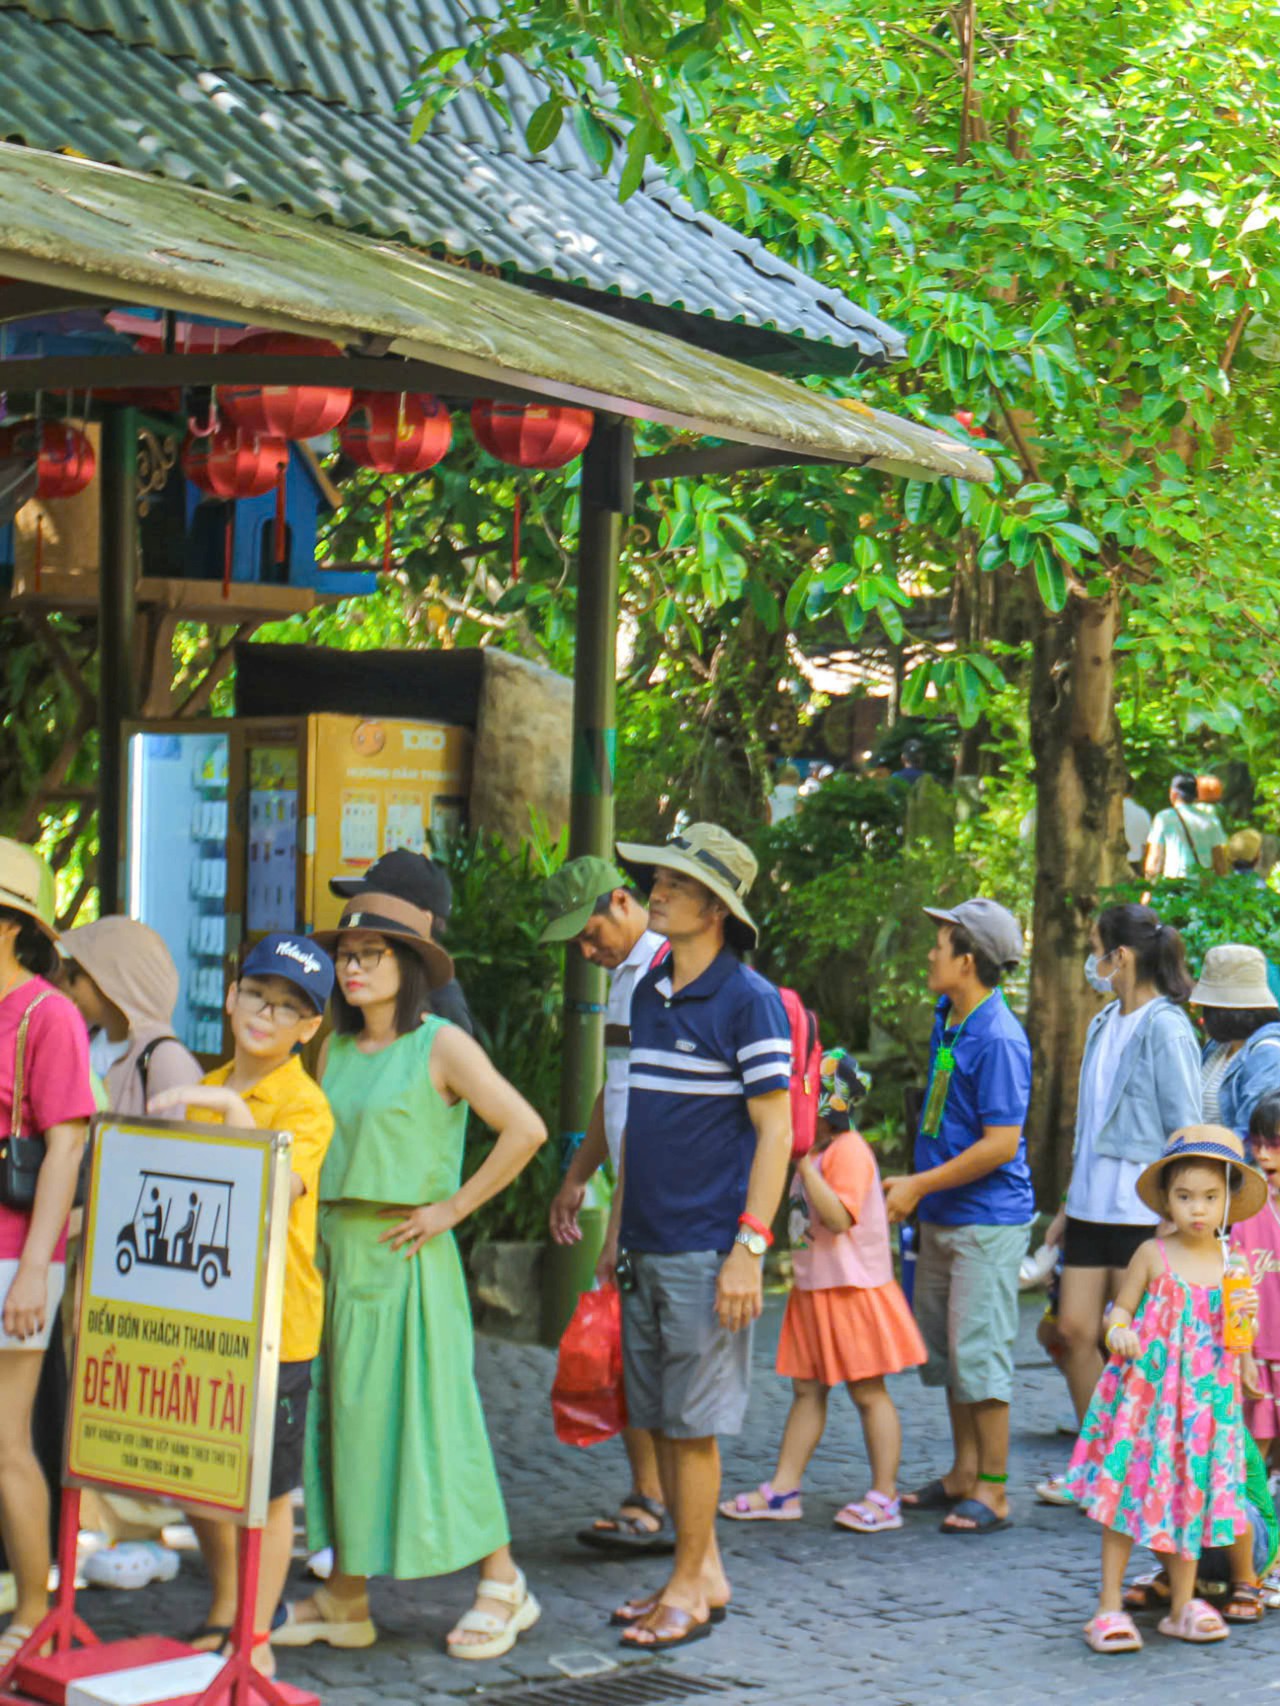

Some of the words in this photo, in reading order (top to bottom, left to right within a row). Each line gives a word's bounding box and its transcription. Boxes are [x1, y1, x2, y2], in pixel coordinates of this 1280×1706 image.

[88, 1302, 115, 1336] ĐIỂM
[117, 1312, 140, 1340] ĐÓN
[142, 1317, 180, 1347] KHÁCH
[183, 1325, 216, 1353] THAM
[218, 1332, 250, 1359] QUAN
[208, 1370, 246, 1435] TÀI
